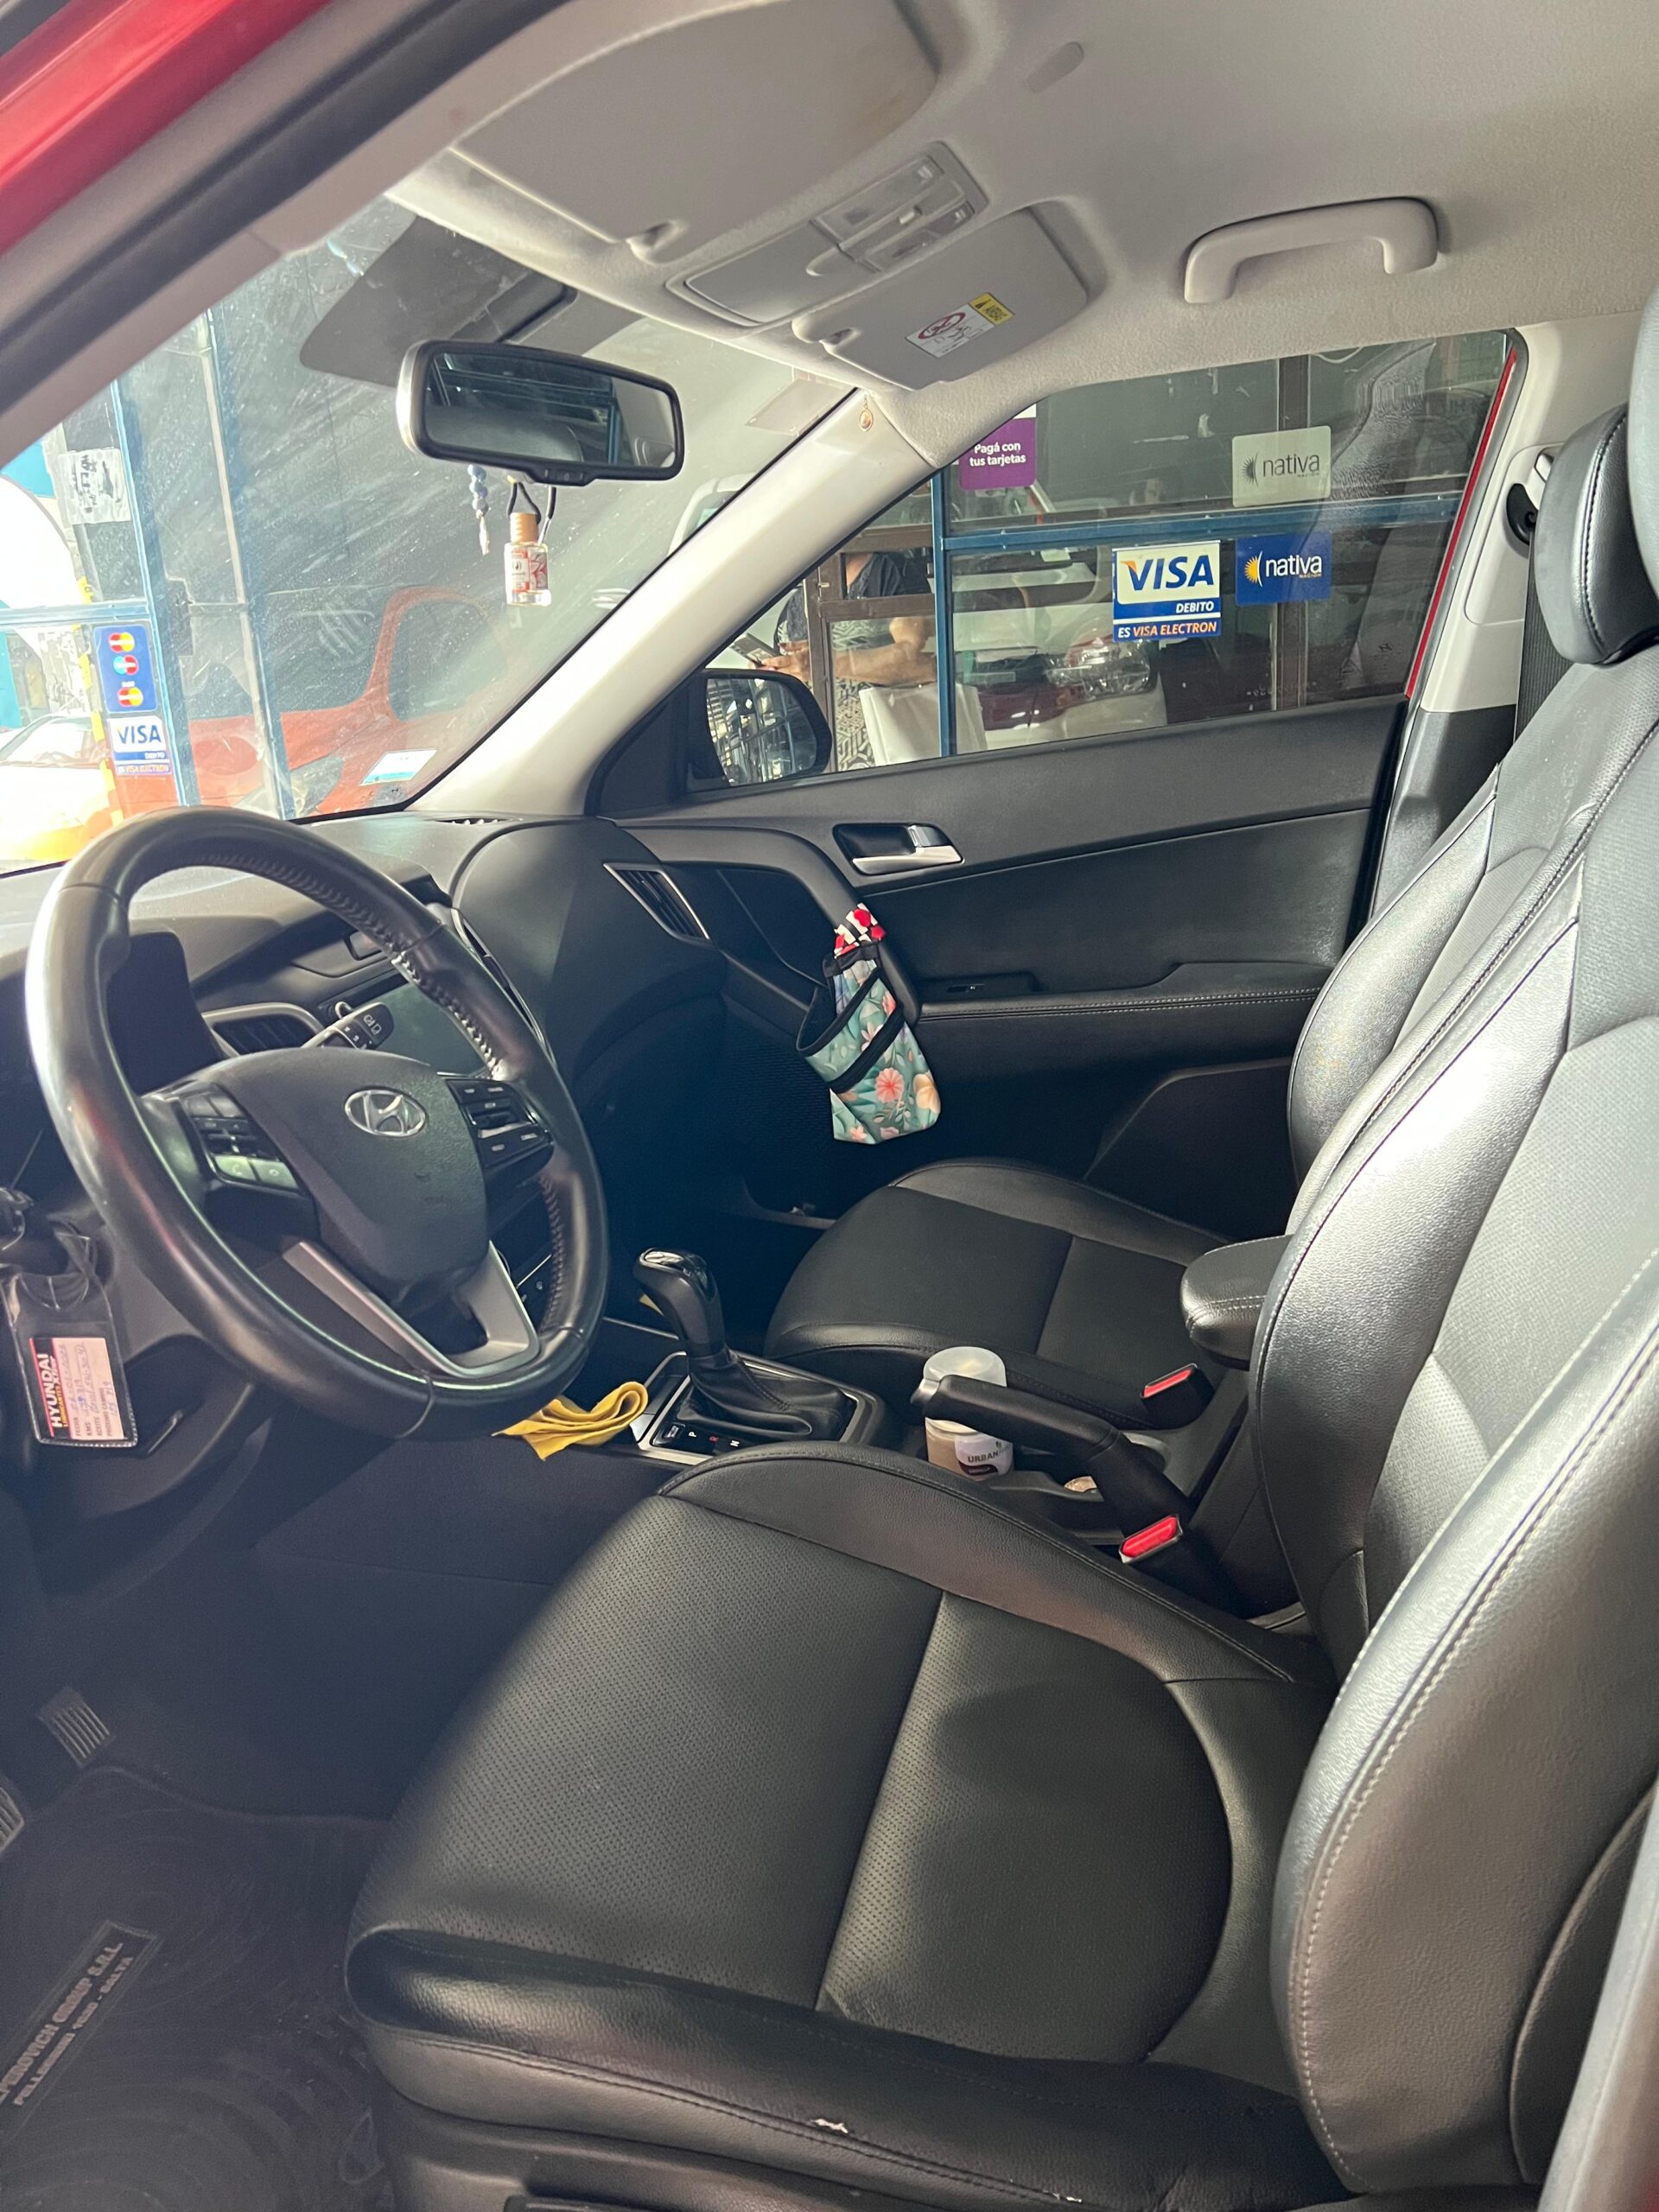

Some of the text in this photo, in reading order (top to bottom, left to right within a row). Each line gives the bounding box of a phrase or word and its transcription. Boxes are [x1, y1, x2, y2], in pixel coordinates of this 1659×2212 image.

[974, 442, 1021, 454] Pagá con
[969, 454, 1027, 467] tus tarjetas
[1262, 454, 1319, 477] nativa
[1120, 555, 1214, 591] VISA
[1265, 555, 1322, 577] nativa
[1175, 601, 1215, 614] DEBITO
[1117, 621, 1217, 639] ES VISA ELECTRON
[117, 724, 162, 745] VISA
[37, 1353, 63, 1427] HYUNDAI
[968, 1451, 999, 1463] URBAN
